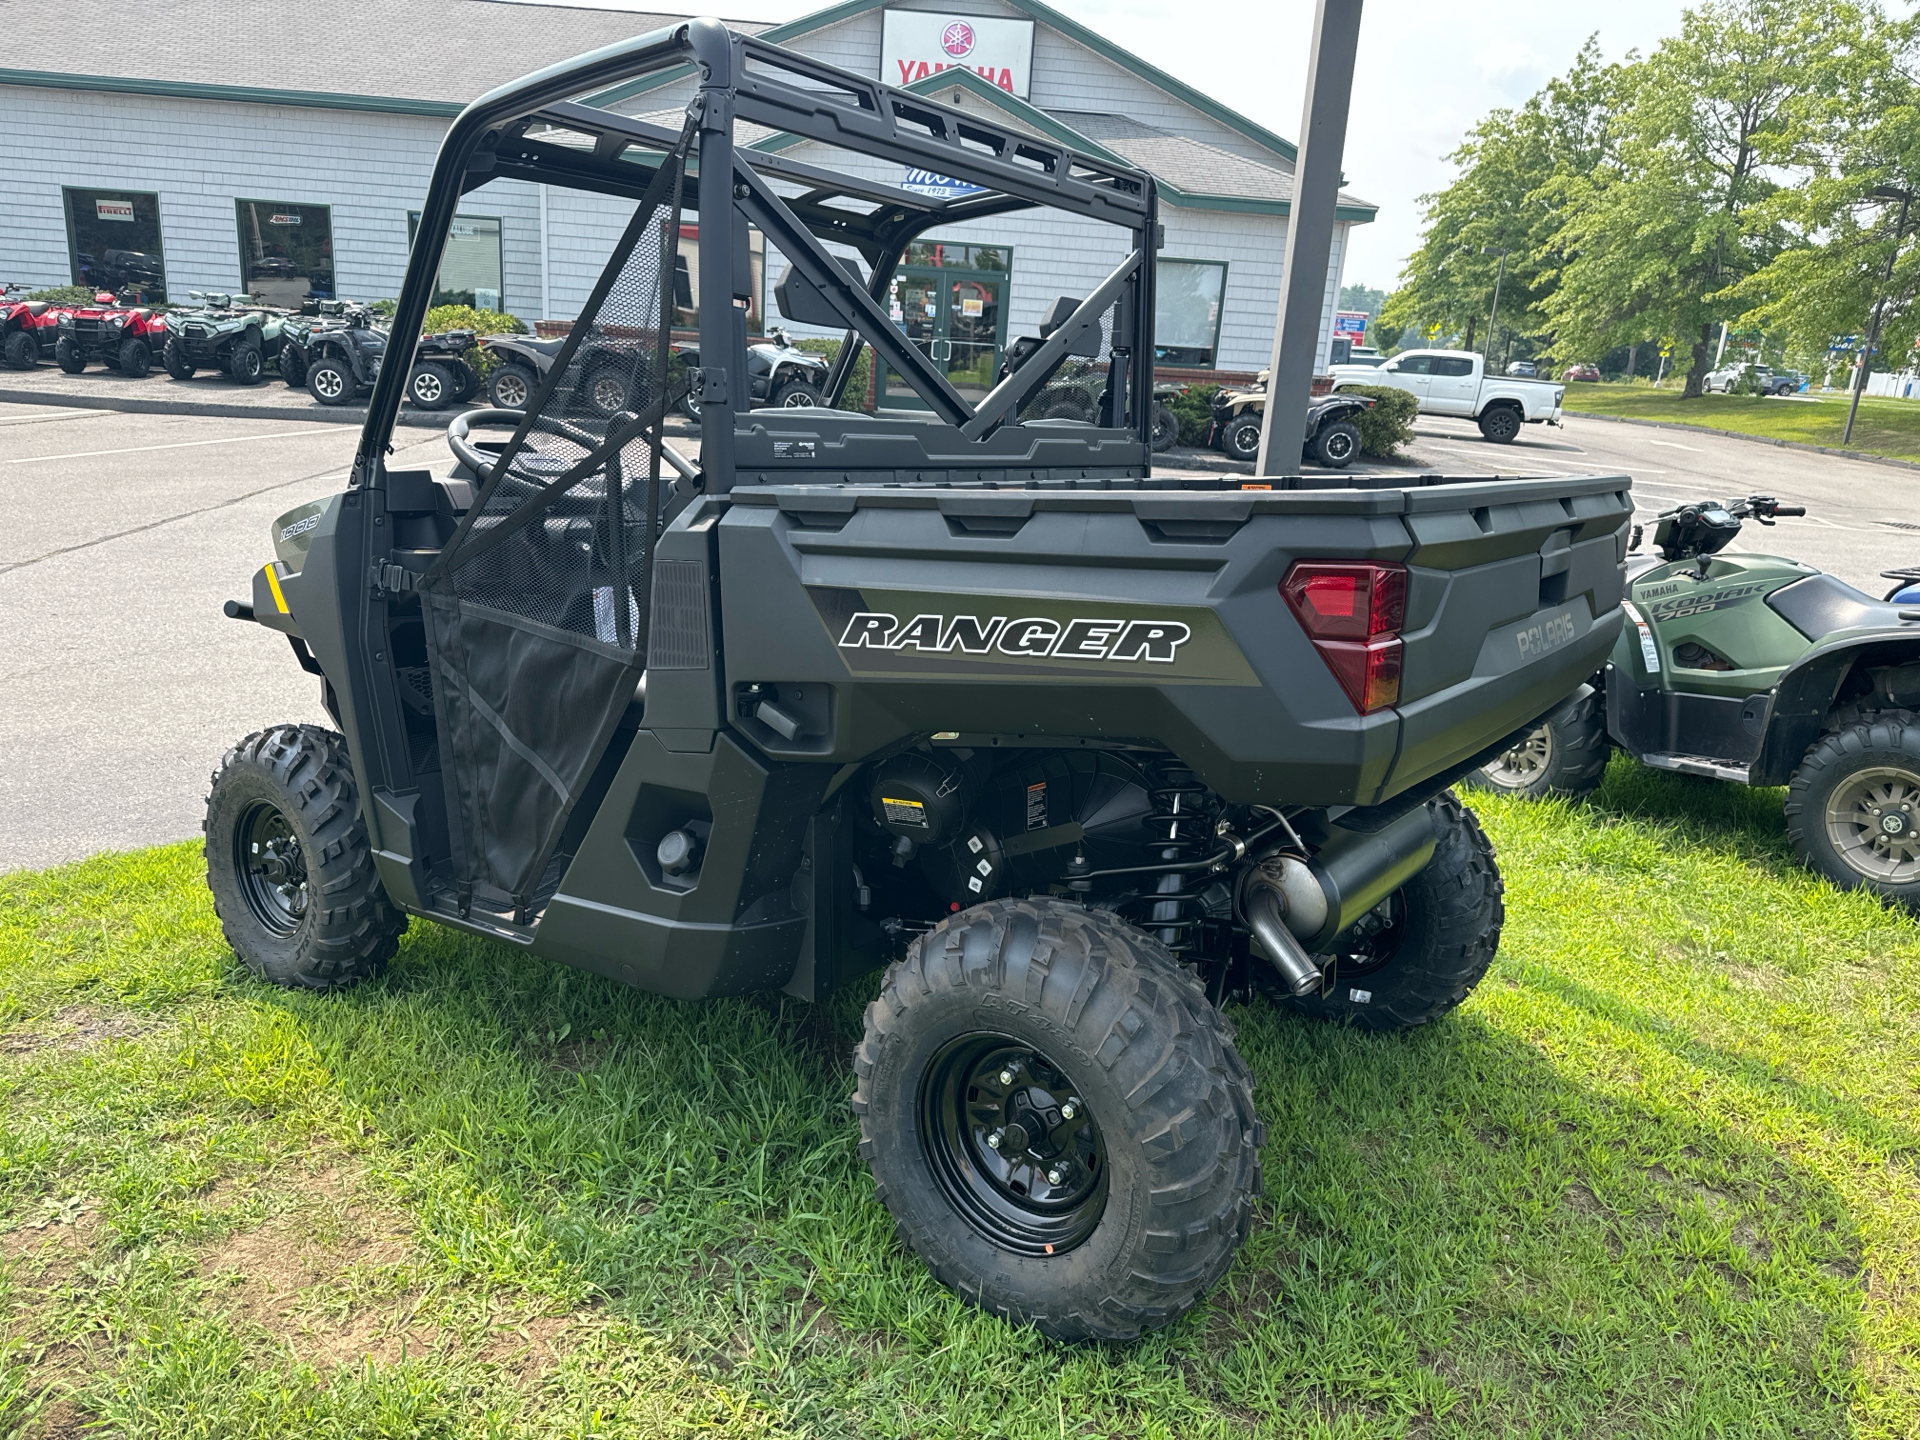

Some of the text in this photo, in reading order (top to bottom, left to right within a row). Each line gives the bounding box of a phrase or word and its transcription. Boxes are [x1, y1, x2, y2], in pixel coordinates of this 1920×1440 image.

[897, 60, 1013, 92] YAHA
[927, 187, 947, 195] 1973
[98, 205, 132, 215] PIRELLI
[280, 513, 321, 543] 1000
[1640, 584, 1679, 600] YAMAHA
[1651, 584, 1768, 613] KODIAK
[1657, 603, 1716, 621] 700
[838, 612, 1192, 662] RANGER
[1516, 612, 1575, 661] POLARIS
